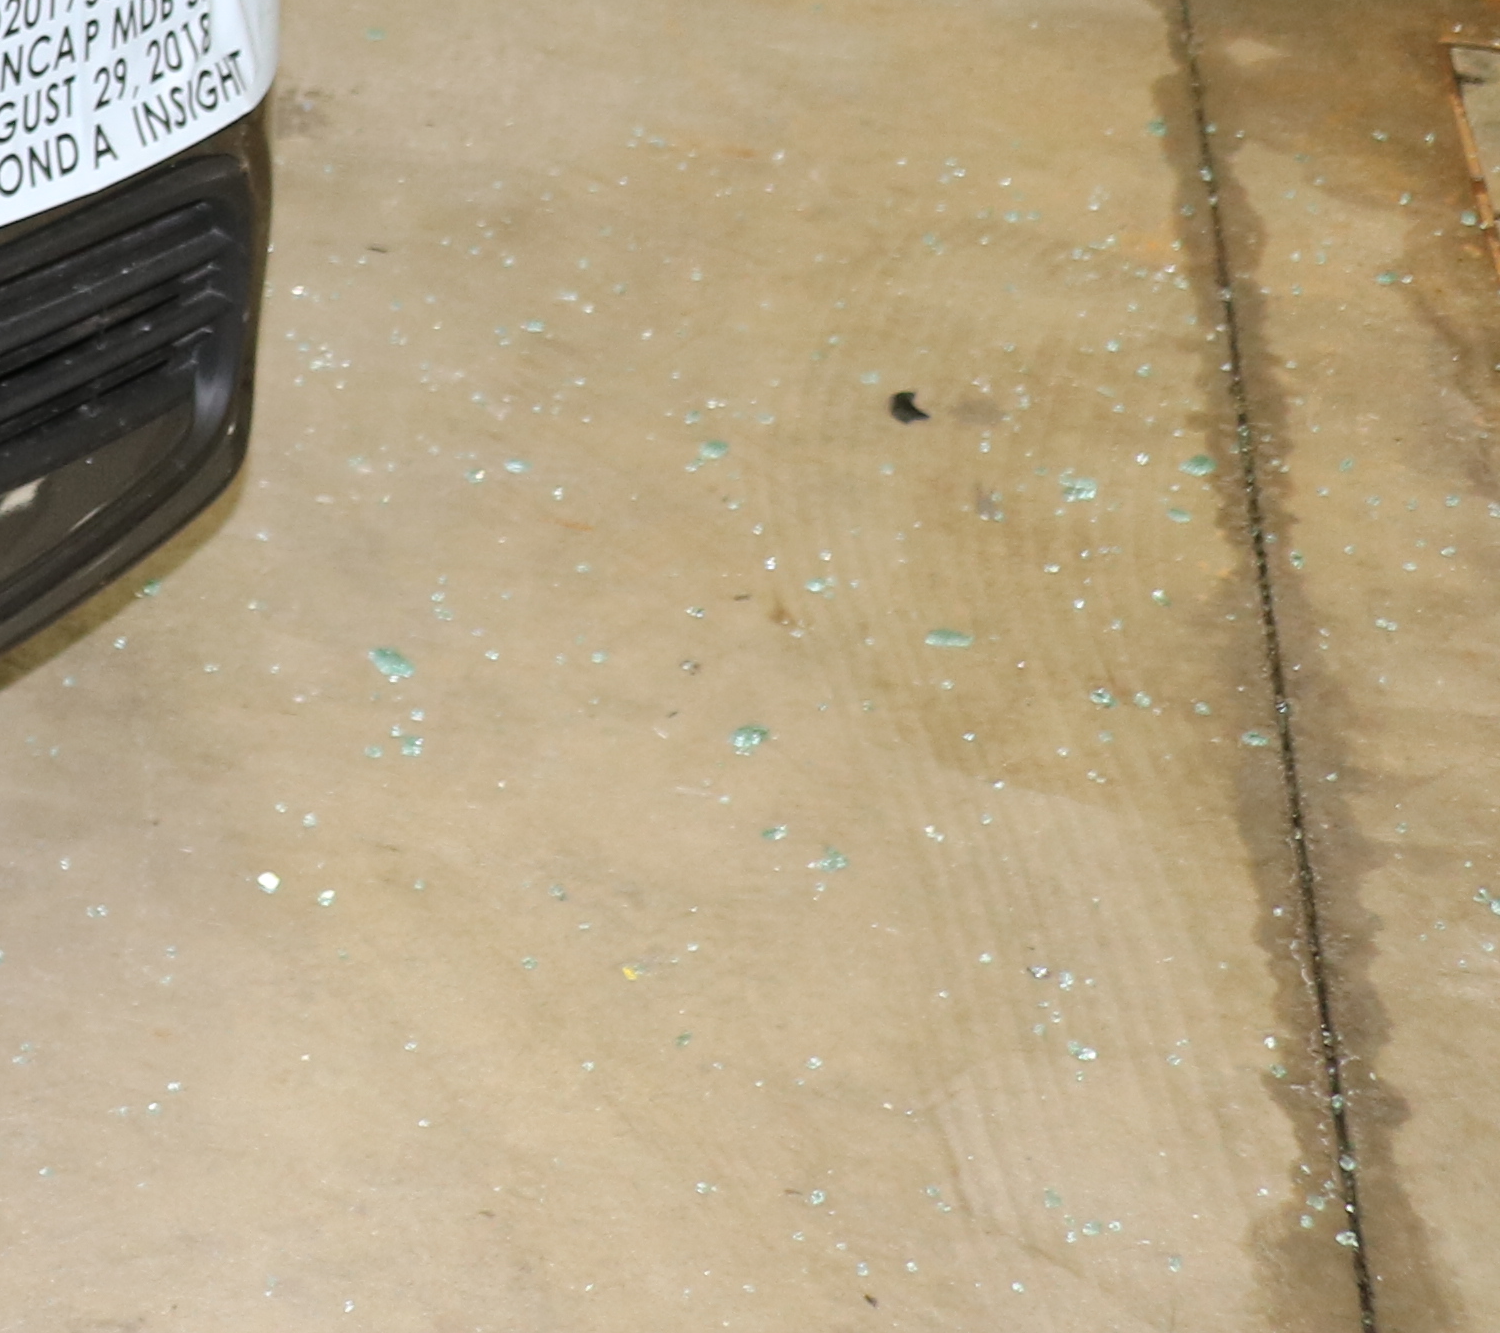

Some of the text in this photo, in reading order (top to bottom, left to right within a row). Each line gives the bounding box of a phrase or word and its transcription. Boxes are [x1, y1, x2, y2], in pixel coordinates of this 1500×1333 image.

[0, 18, 100, 93] NCAP
[93, 57, 140, 112] 29,
[146, 12, 212, 84] 2018
[132, 49, 247, 148] INSIGHT
